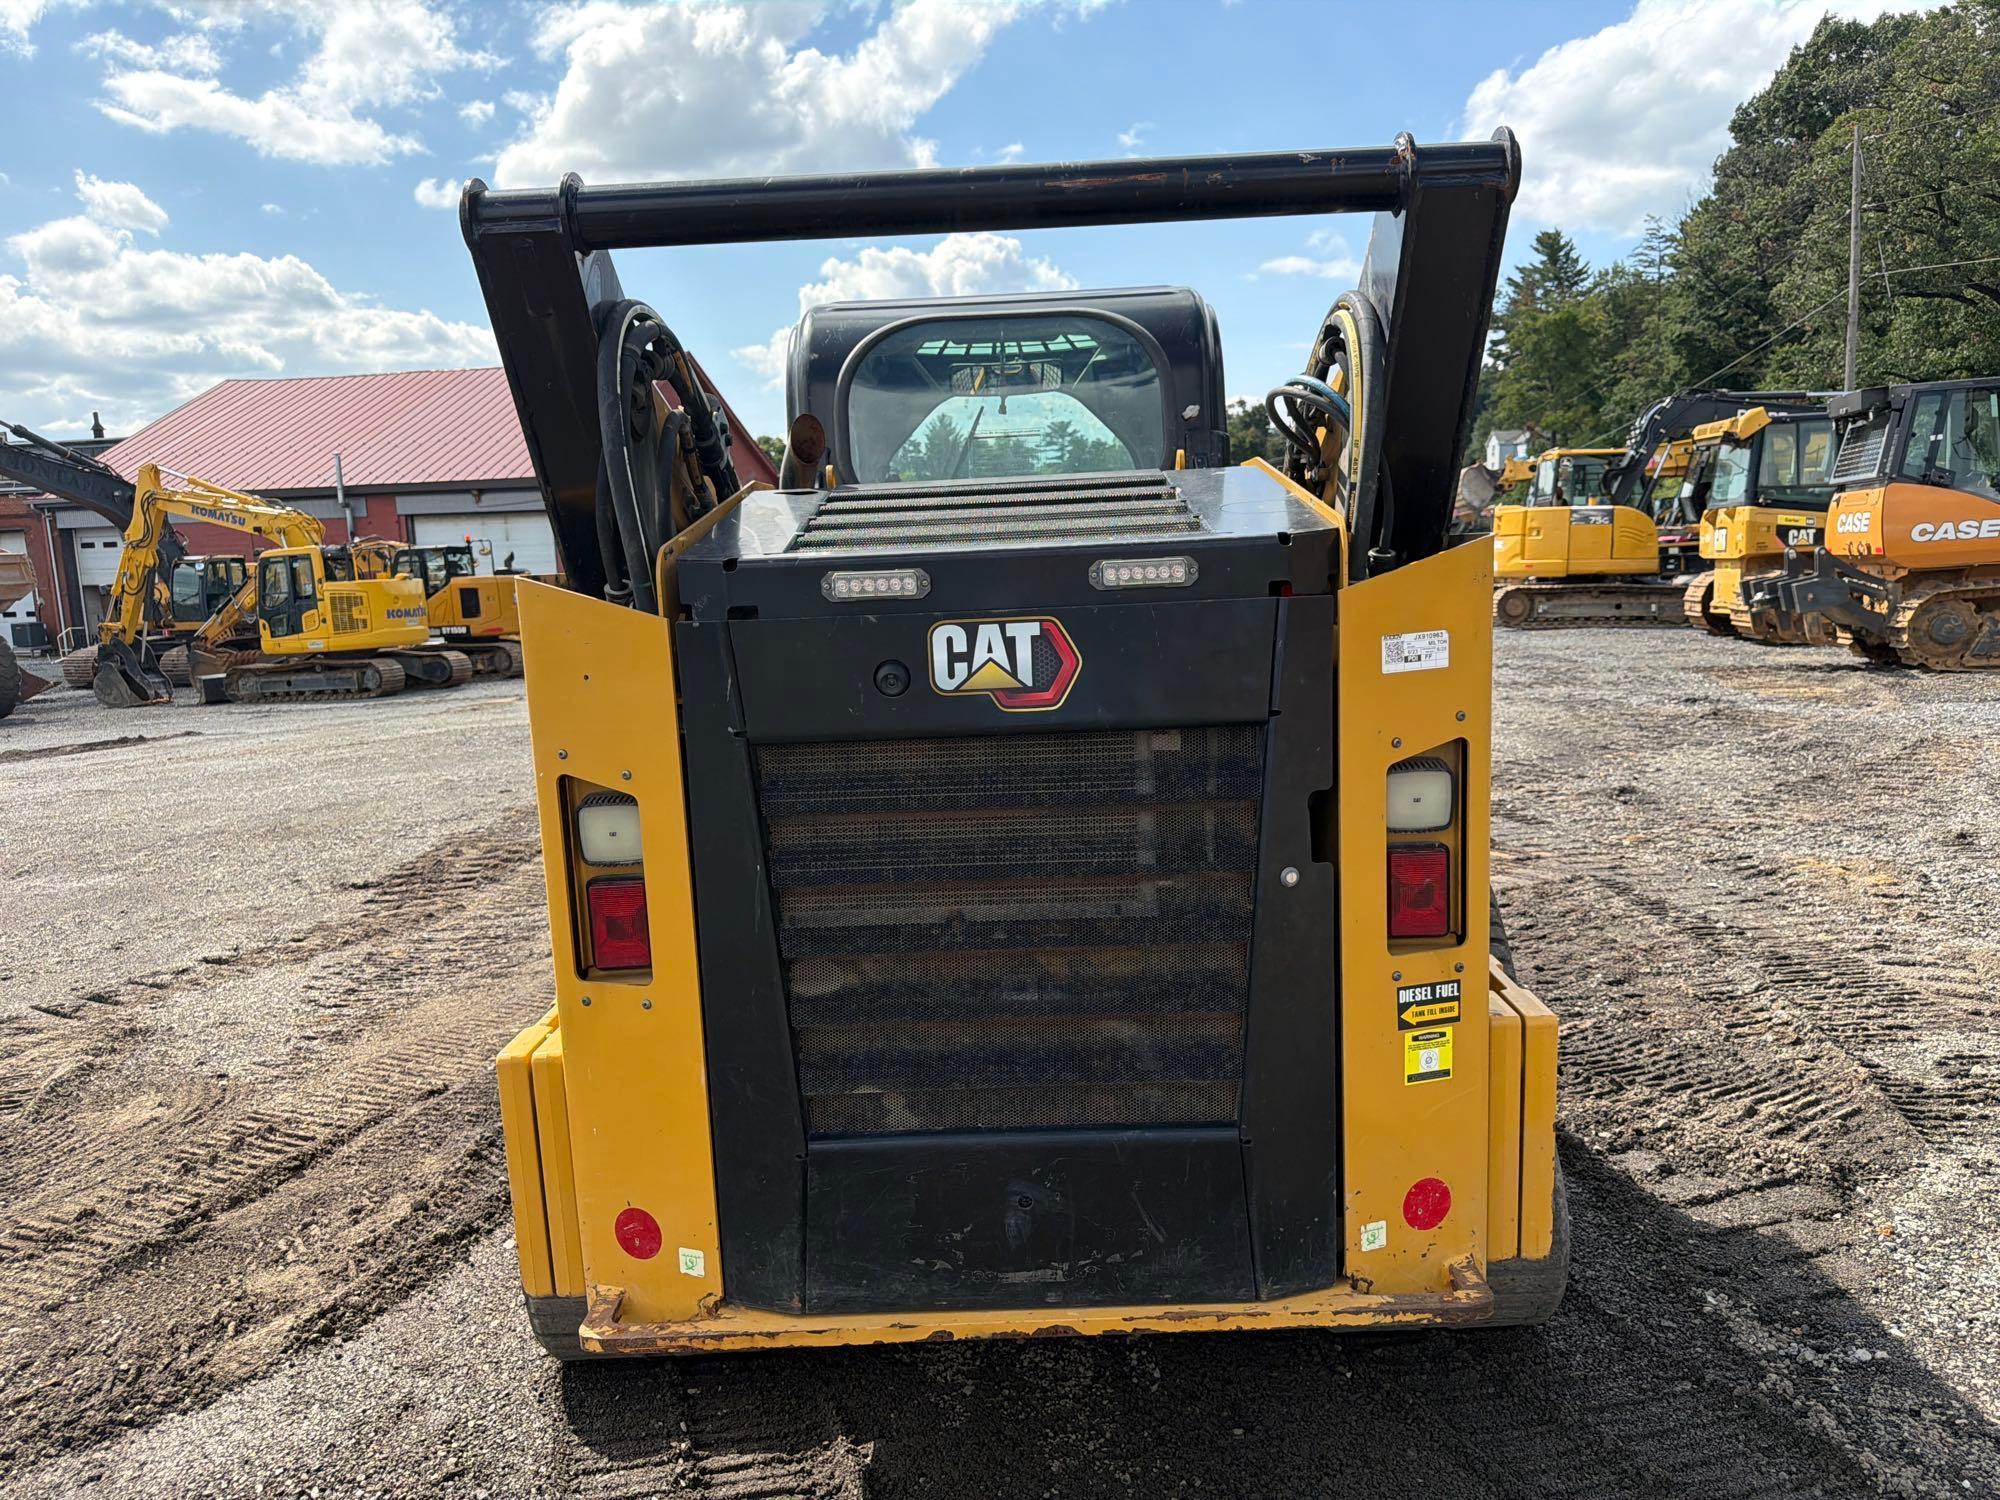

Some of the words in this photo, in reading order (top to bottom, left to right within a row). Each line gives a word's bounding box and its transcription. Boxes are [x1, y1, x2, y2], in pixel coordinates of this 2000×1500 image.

[191, 503, 246, 526] KOMATSU
[1837, 511, 1872, 534] CASE
[1788, 528, 1816, 546] CAT
[1911, 518, 2000, 542] CASE
[932, 621, 1041, 691] CAT
[1399, 987, 1433, 1003] DIESEL
[1436, 982, 1460, 998] FUEL
[1411, 1009, 1426, 1019] TANK
[1427, 1007, 1437, 1016] FILL
[1439, 1005, 1456, 1014] INSIDE
